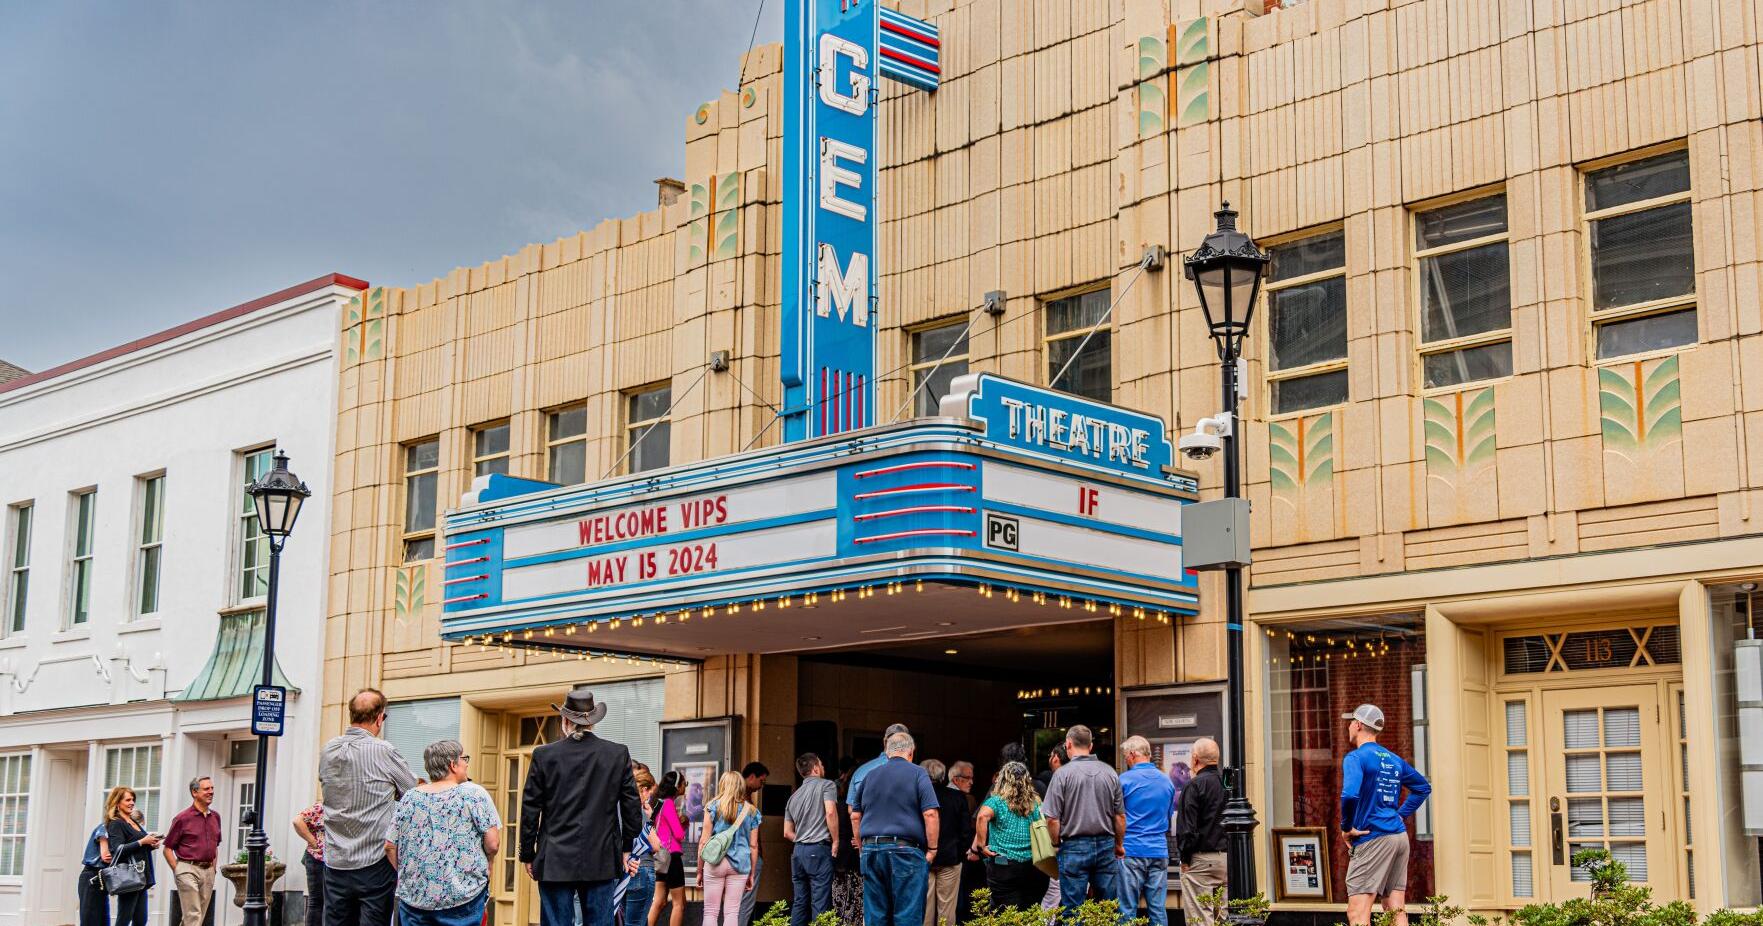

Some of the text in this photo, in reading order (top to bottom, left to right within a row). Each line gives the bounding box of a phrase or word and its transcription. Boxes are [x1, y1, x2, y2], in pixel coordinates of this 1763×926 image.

[817, 33, 870, 327] GEM
[1001, 397, 1150, 468] THEATRE
[579, 496, 727, 545] WELCOME VIPS
[1079, 487, 1098, 516] IF
[989, 519, 1017, 546] PG
[588, 543, 717, 587] MAY 15 2024
[1586, 639, 1611, 661] 113
